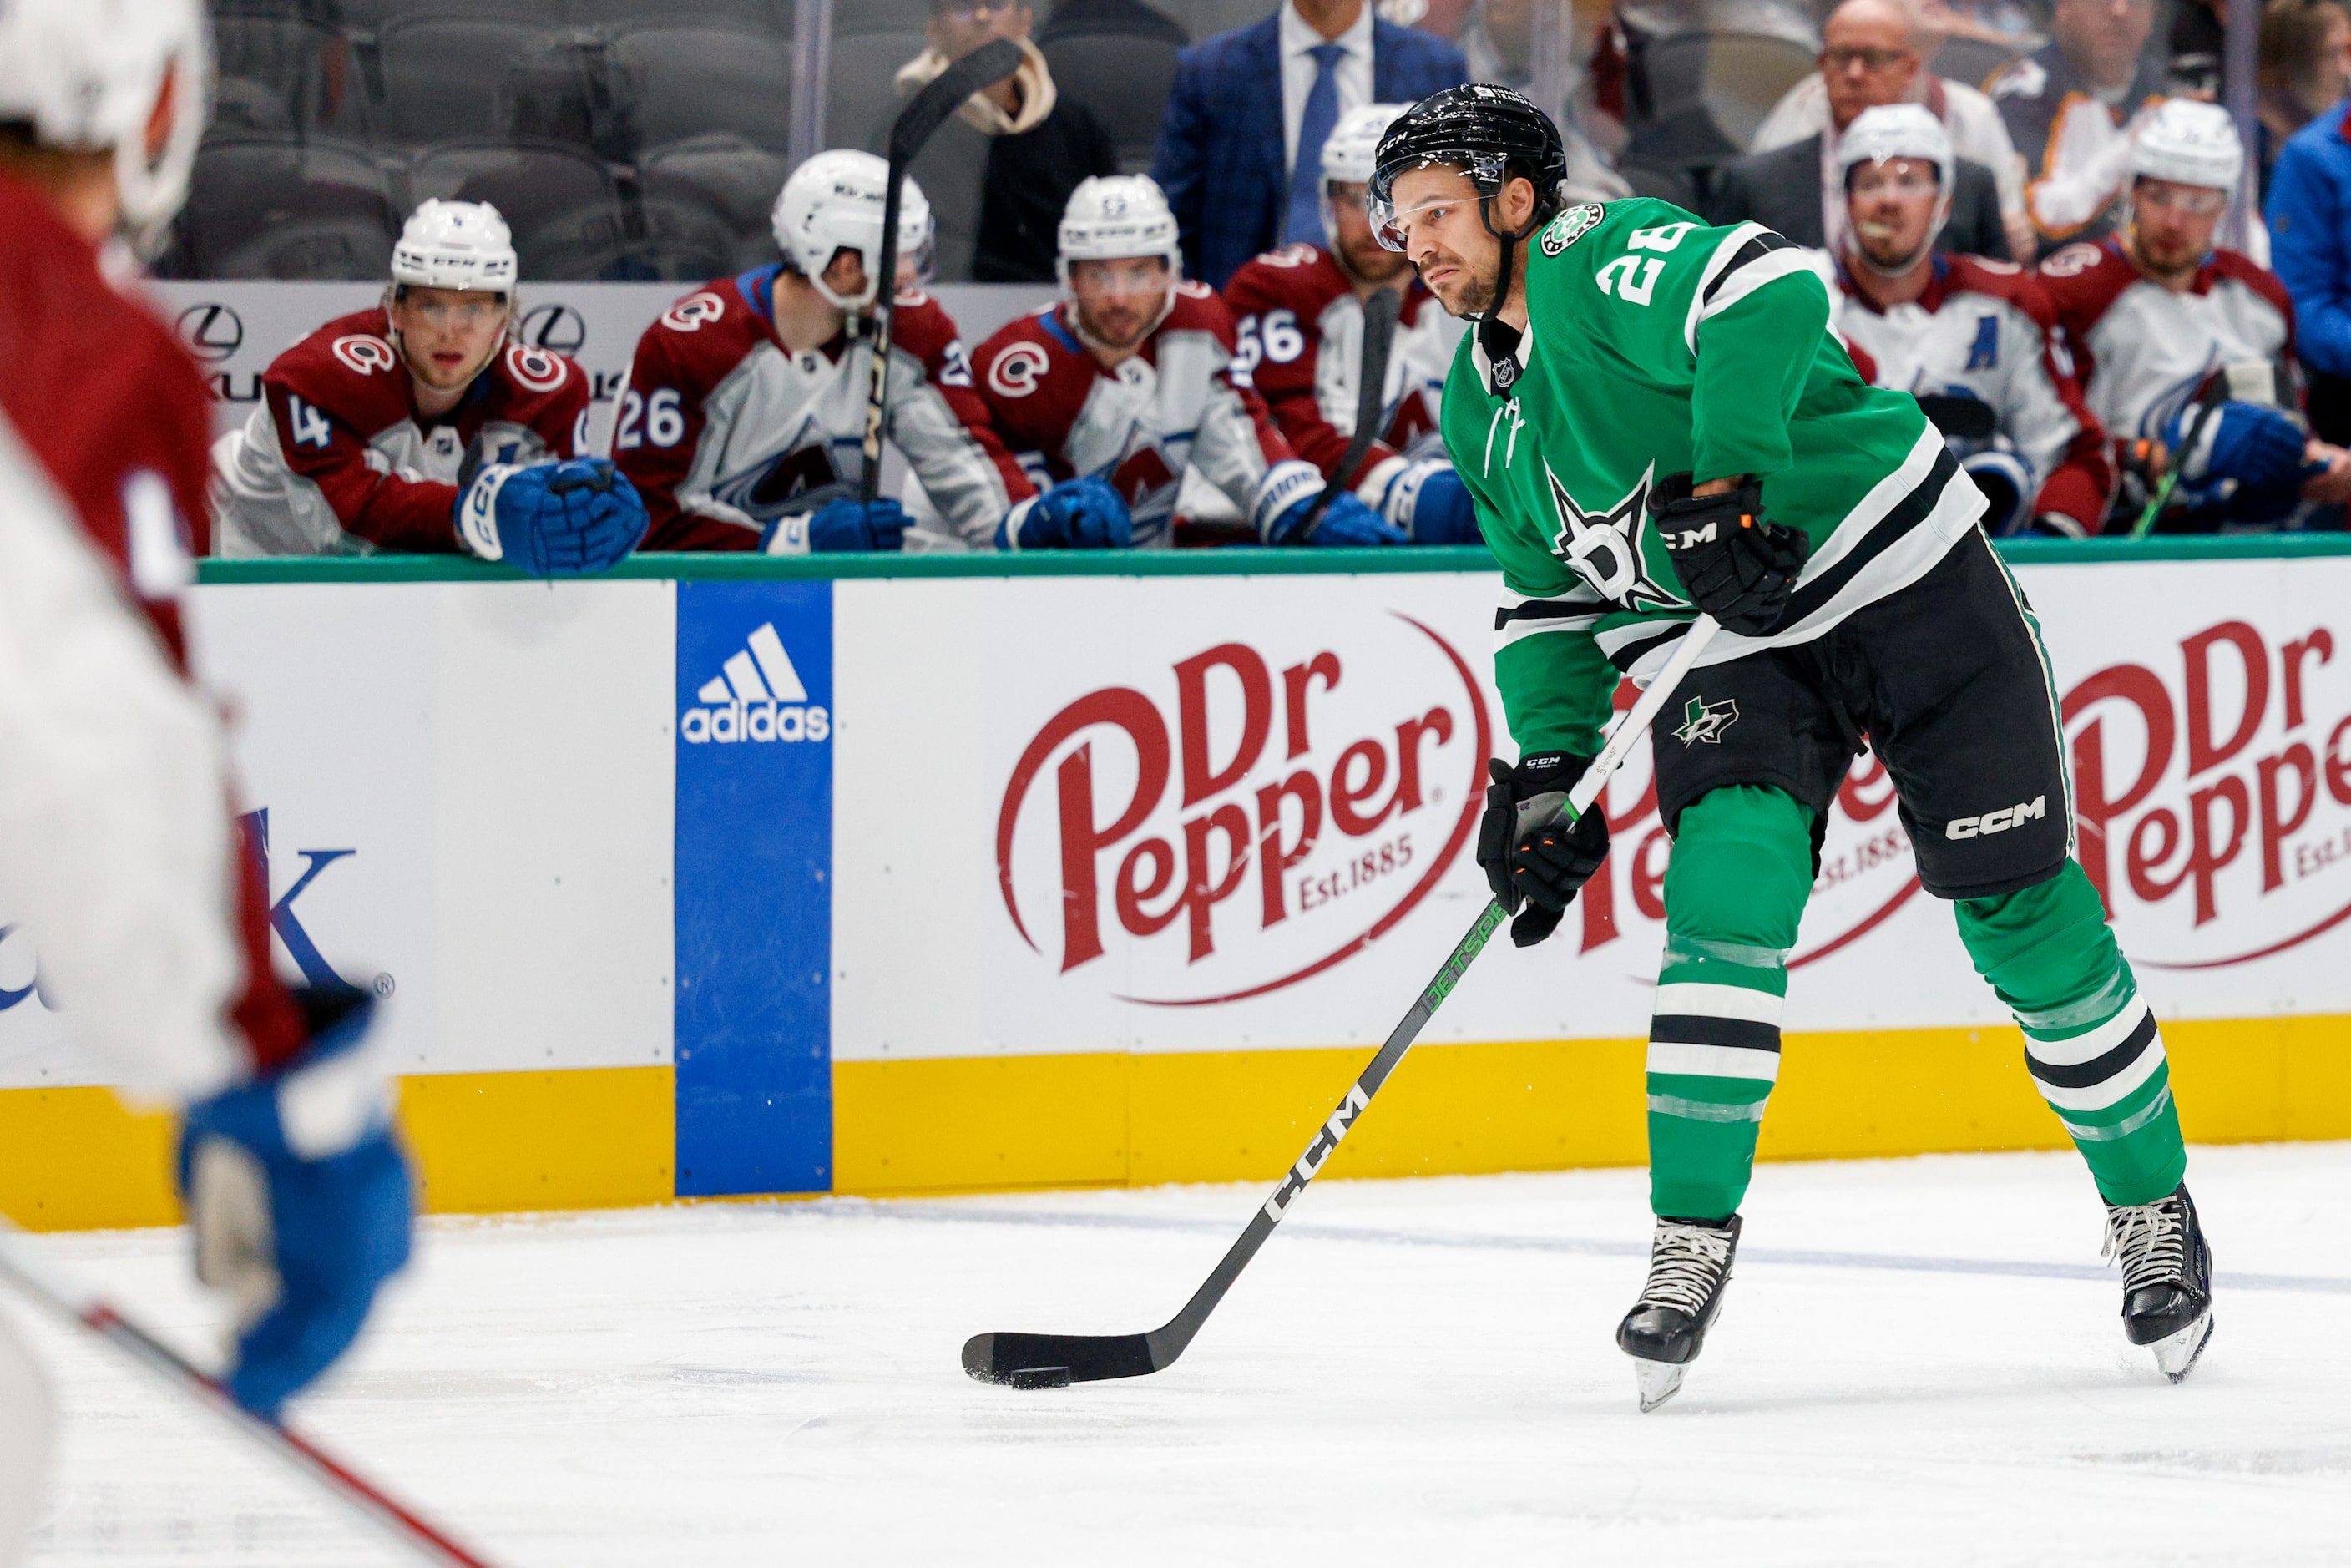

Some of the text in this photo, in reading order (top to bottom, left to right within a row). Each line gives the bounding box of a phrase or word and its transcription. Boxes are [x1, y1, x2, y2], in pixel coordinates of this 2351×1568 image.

[1378, 130, 1408, 157] CCM
[1595, 221, 1699, 307] 28
[1236, 308, 1304, 372] 56
[1965, 315, 1998, 370] A
[287, 394, 331, 448] 4
[616, 387, 687, 449] 26
[681, 702, 830, 744] adidas
[1171, 642, 1342, 808] Dr
[2180, 620, 2333, 781] Dr
[1526, 756, 1560, 767] CCM
[997, 686, 1453, 974] Pepper
[1945, 795, 2045, 840] CCM
[1264, 1081, 1371, 1223] CCM
